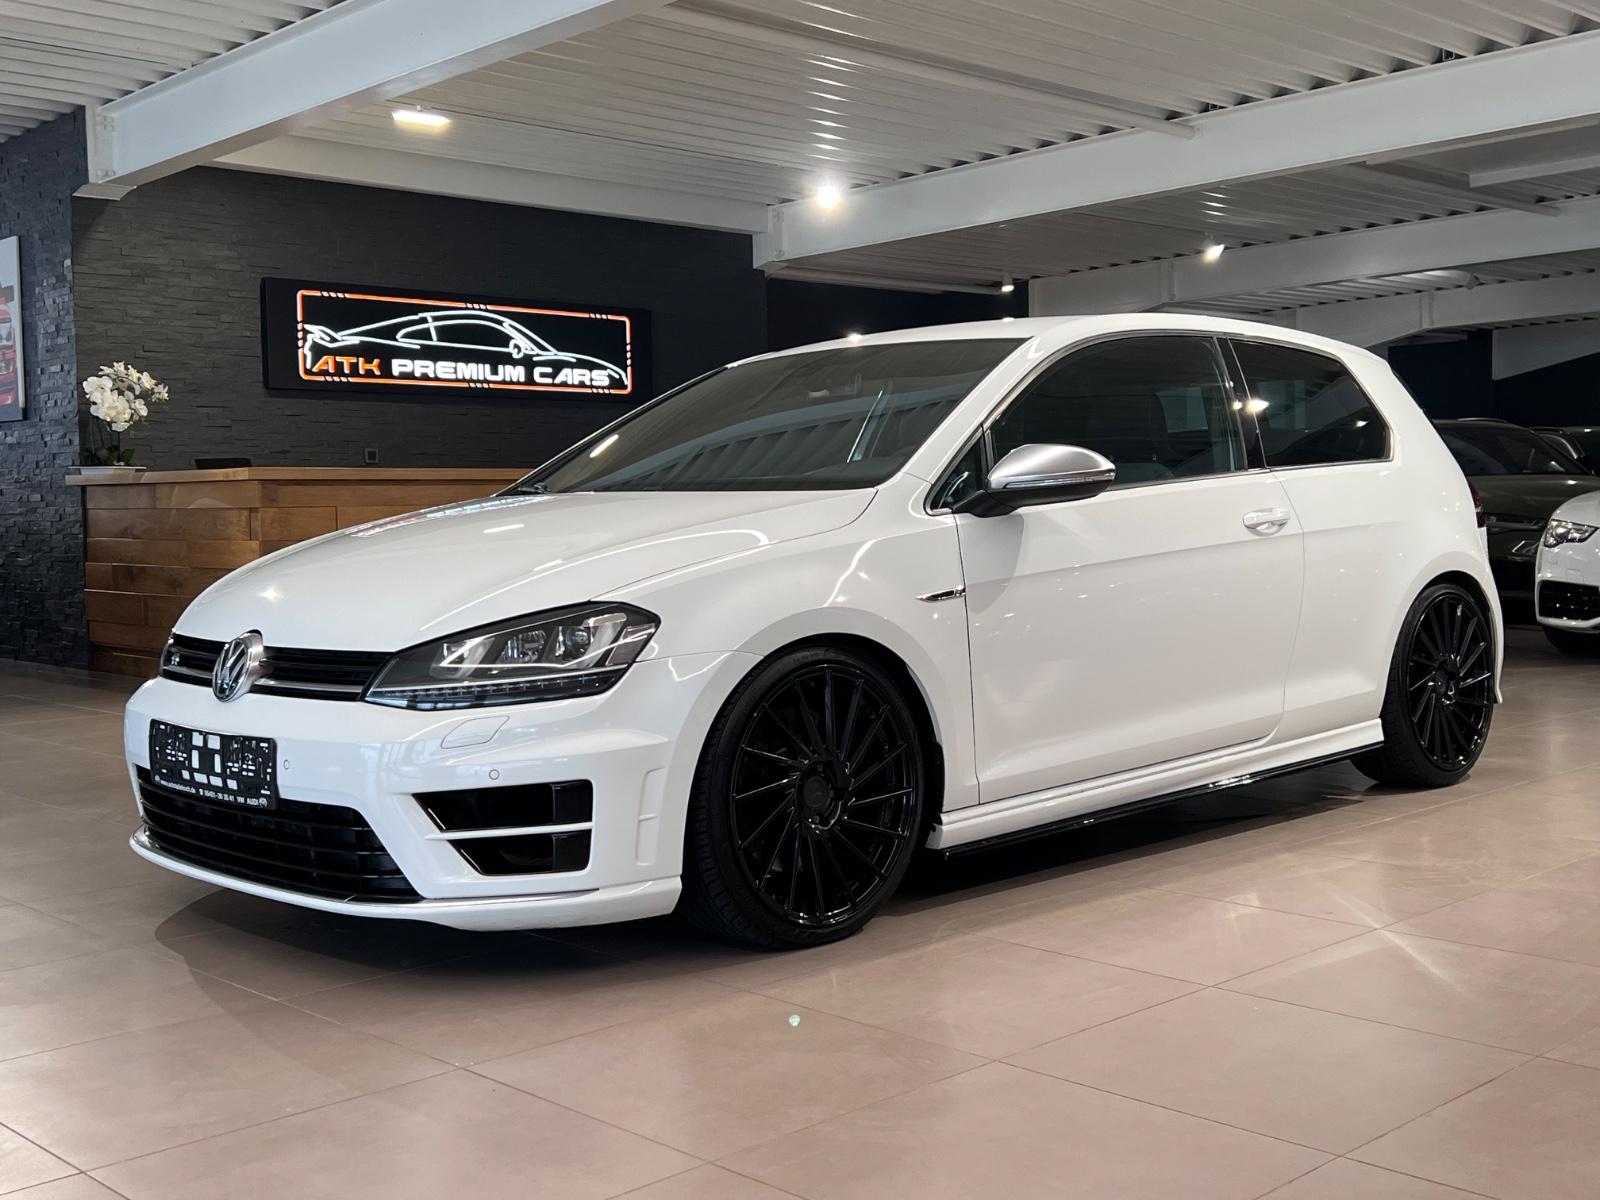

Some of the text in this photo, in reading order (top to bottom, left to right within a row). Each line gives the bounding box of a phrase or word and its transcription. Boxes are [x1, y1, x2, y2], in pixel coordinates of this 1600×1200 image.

[312, 355, 610, 387] ATK PREMIUM CARS
